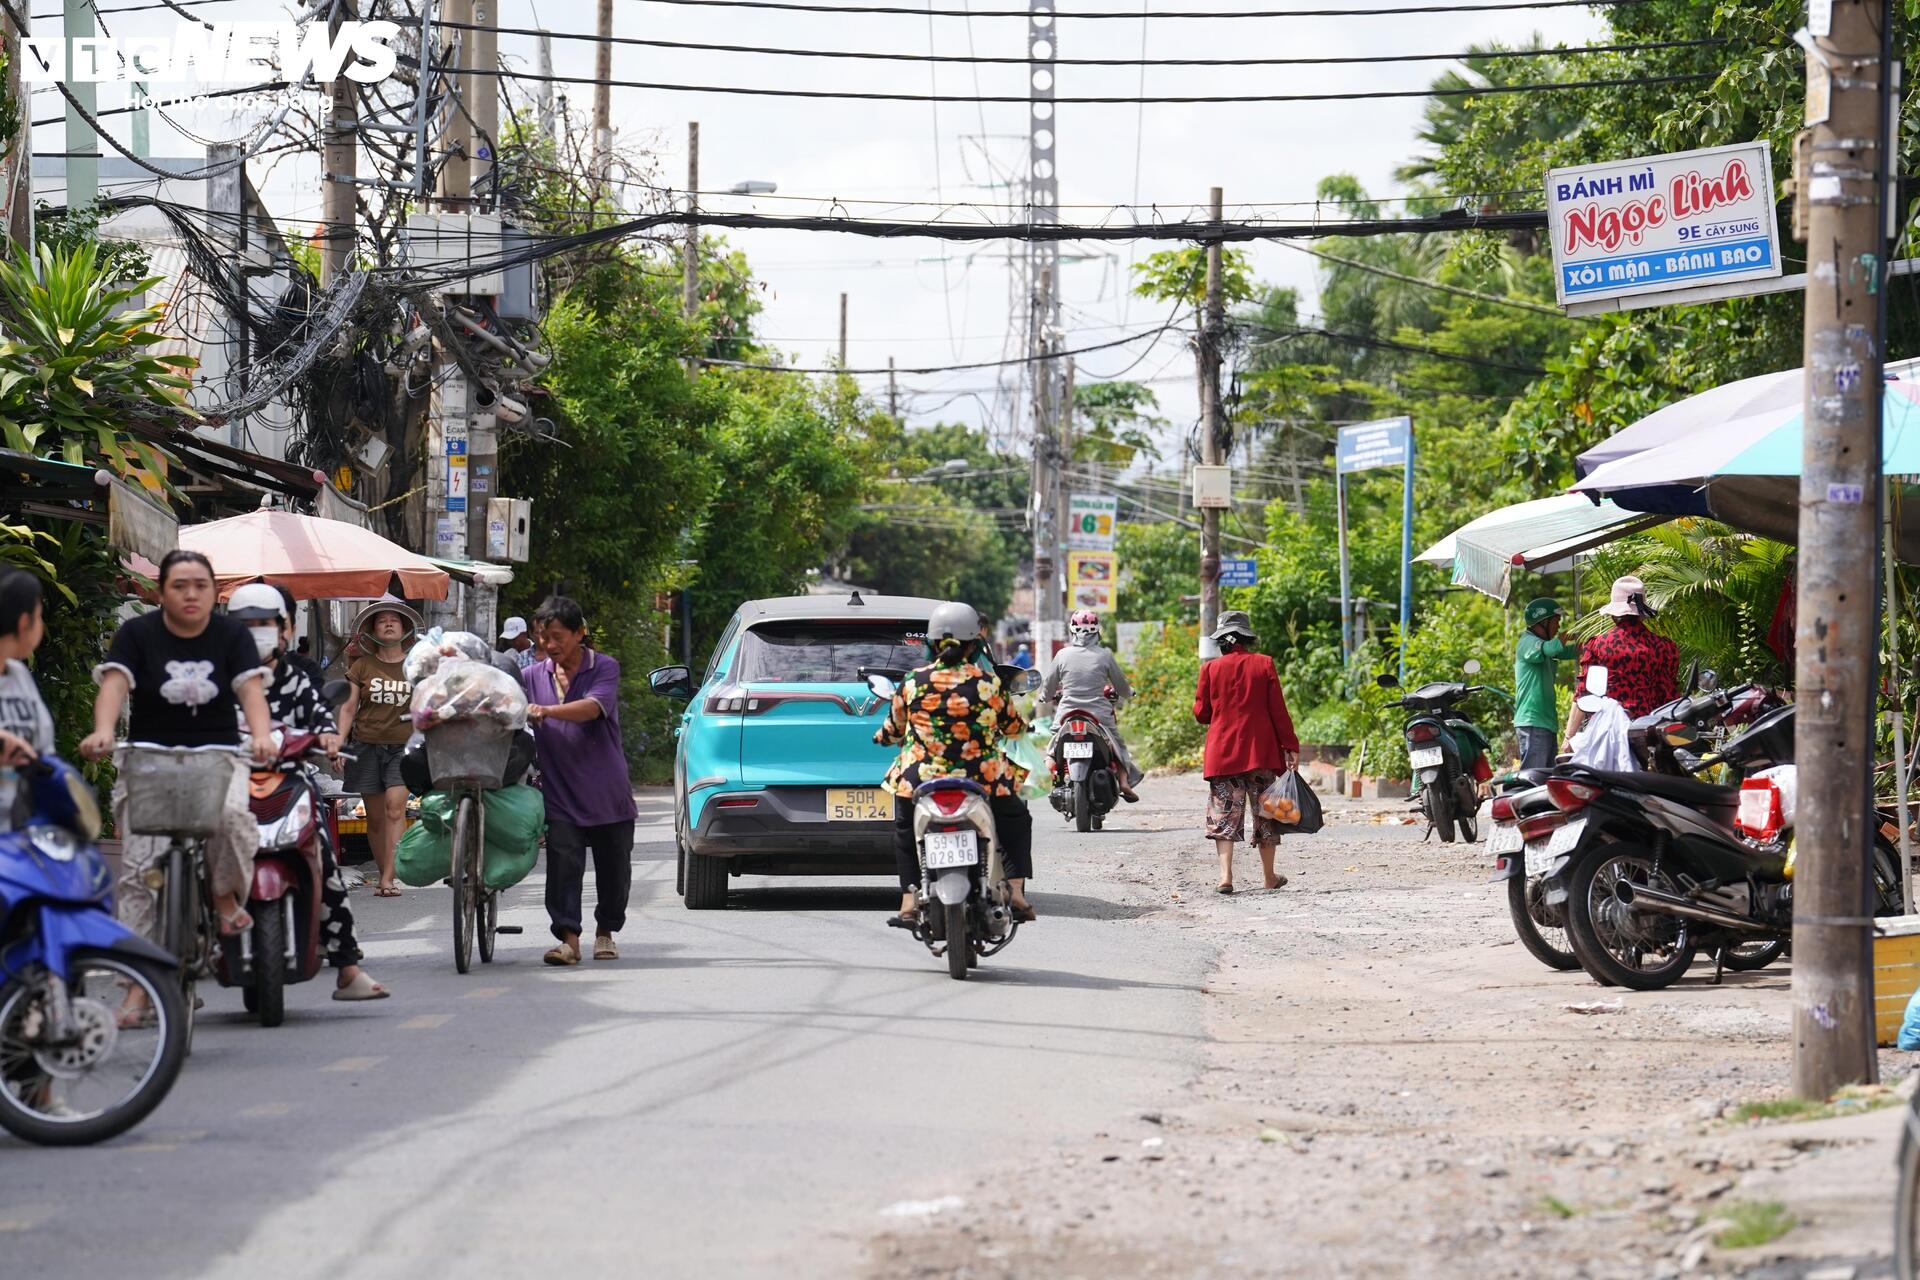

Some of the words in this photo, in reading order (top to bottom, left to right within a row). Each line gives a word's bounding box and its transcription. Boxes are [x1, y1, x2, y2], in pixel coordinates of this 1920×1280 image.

[1557, 176, 1623, 201] BÁNH
[1629, 168, 1655, 191] MÌ
[1566, 197, 1665, 253] Ngọc
[1672, 161, 1751, 217] Linh
[1678, 226, 1700, 240] 9E
[1706, 224, 1727, 237] CÂY
[1730, 221, 1759, 235] SUNG
[1568, 266, 1602, 286] XÔI
[1666, 252, 1716, 273] BÁNH
[1722, 246, 1762, 266] BAO
[369, 678, 411, 693] Sun
[370, 690, 411, 706] day
[846, 791, 875, 804] 50H
[835, 805, 887, 818] 561.24
[930, 849, 974, 865] 028.96
